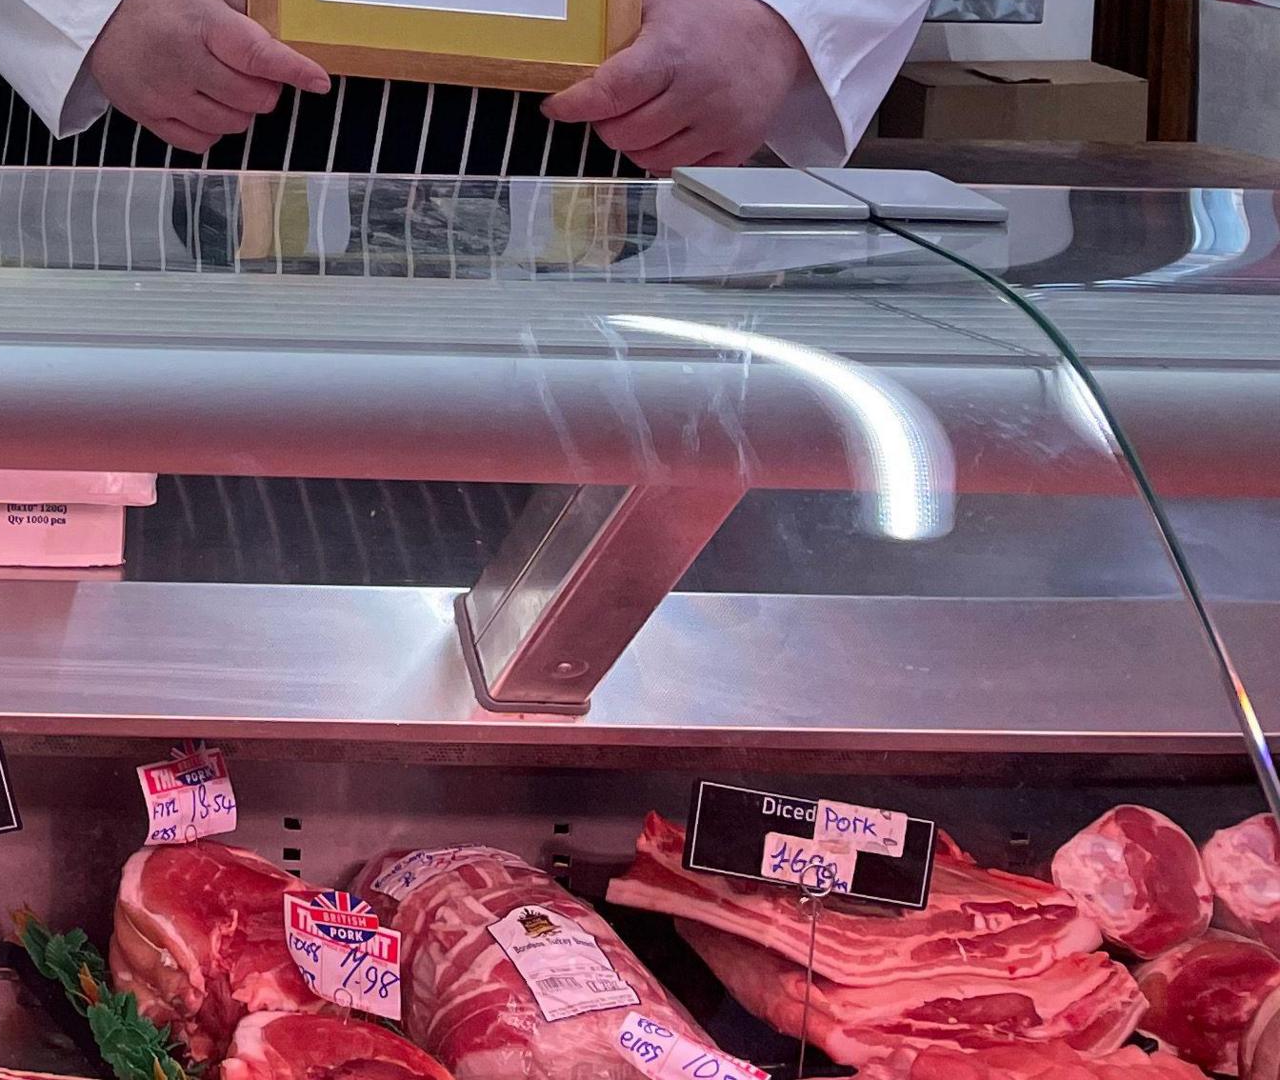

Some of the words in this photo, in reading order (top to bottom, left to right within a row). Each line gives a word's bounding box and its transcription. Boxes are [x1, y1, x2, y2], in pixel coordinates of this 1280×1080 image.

[7, 515, 24, 525] Qty
[26, 515, 49, 524] 1000
[50, 516, 67, 525] pcs
[185, 767, 214, 786] PORK
[762, 796, 818, 822] Diced
[824, 806, 877, 838] Pork
[322, 911, 368, 929] BRITISH
[329, 926, 364, 942] PORK
